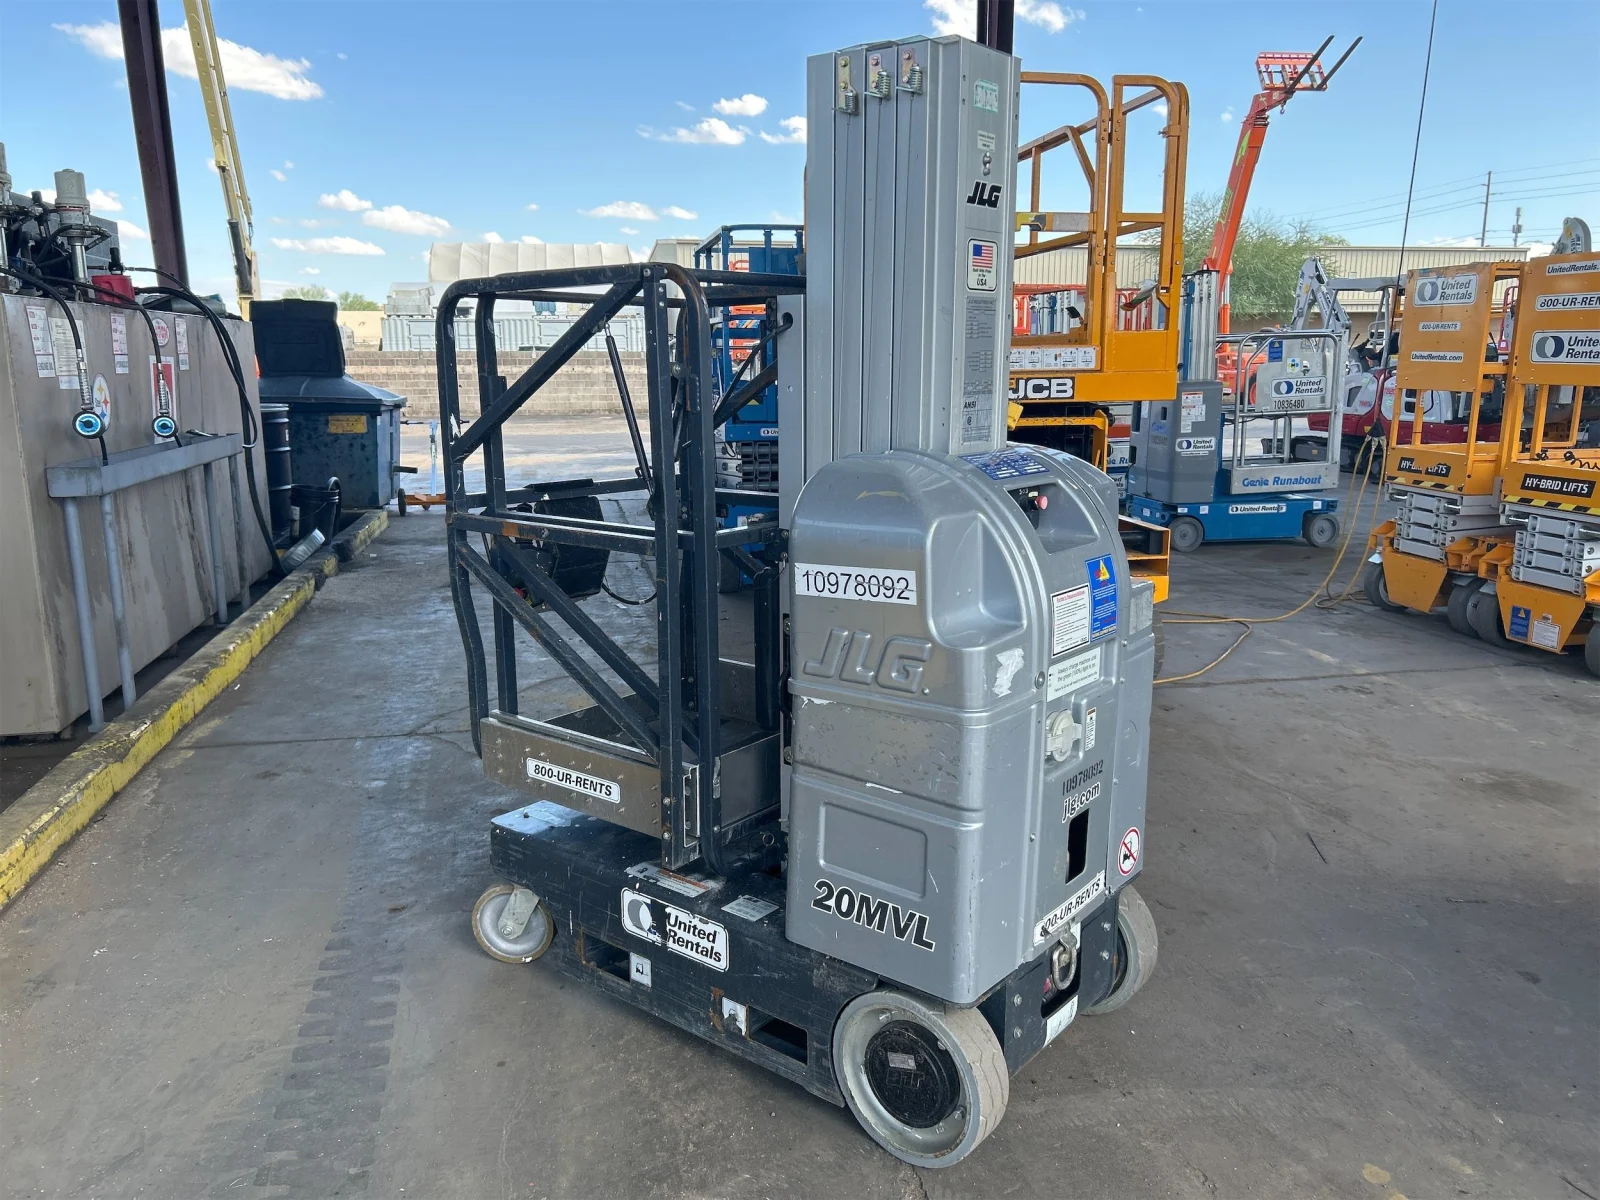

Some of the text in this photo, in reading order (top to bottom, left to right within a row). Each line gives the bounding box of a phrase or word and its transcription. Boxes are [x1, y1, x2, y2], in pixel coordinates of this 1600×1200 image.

[966, 181, 1002, 208] JLG
[977, 278, 987, 286] USA
[1440, 290, 1472, 300] Rentals
[1441, 279, 1472, 290] United
[1568, 336, 1600, 347] Unite
[1008, 379, 1073, 399] JCB
[1274, 399, 1304, 410] 10836480
[1243, 475, 1322, 487] Genie Runabout
[1525, 478, 1588, 494] HY-BRID LIFTS
[802, 570, 910, 600] 10978092
[803, 628, 932, 694] JLG
[534, 764, 612, 796] 800-UR-RENTS
[1062, 760, 1103, 796] 10978092
[1062, 782, 1100, 823] jlg.com
[811, 879, 936, 952] 20MVL
[1040, 878, 1100, 937] 800-UR-RENTS
[667, 912, 717, 944] United
[667, 928, 722, 963] Rentals
